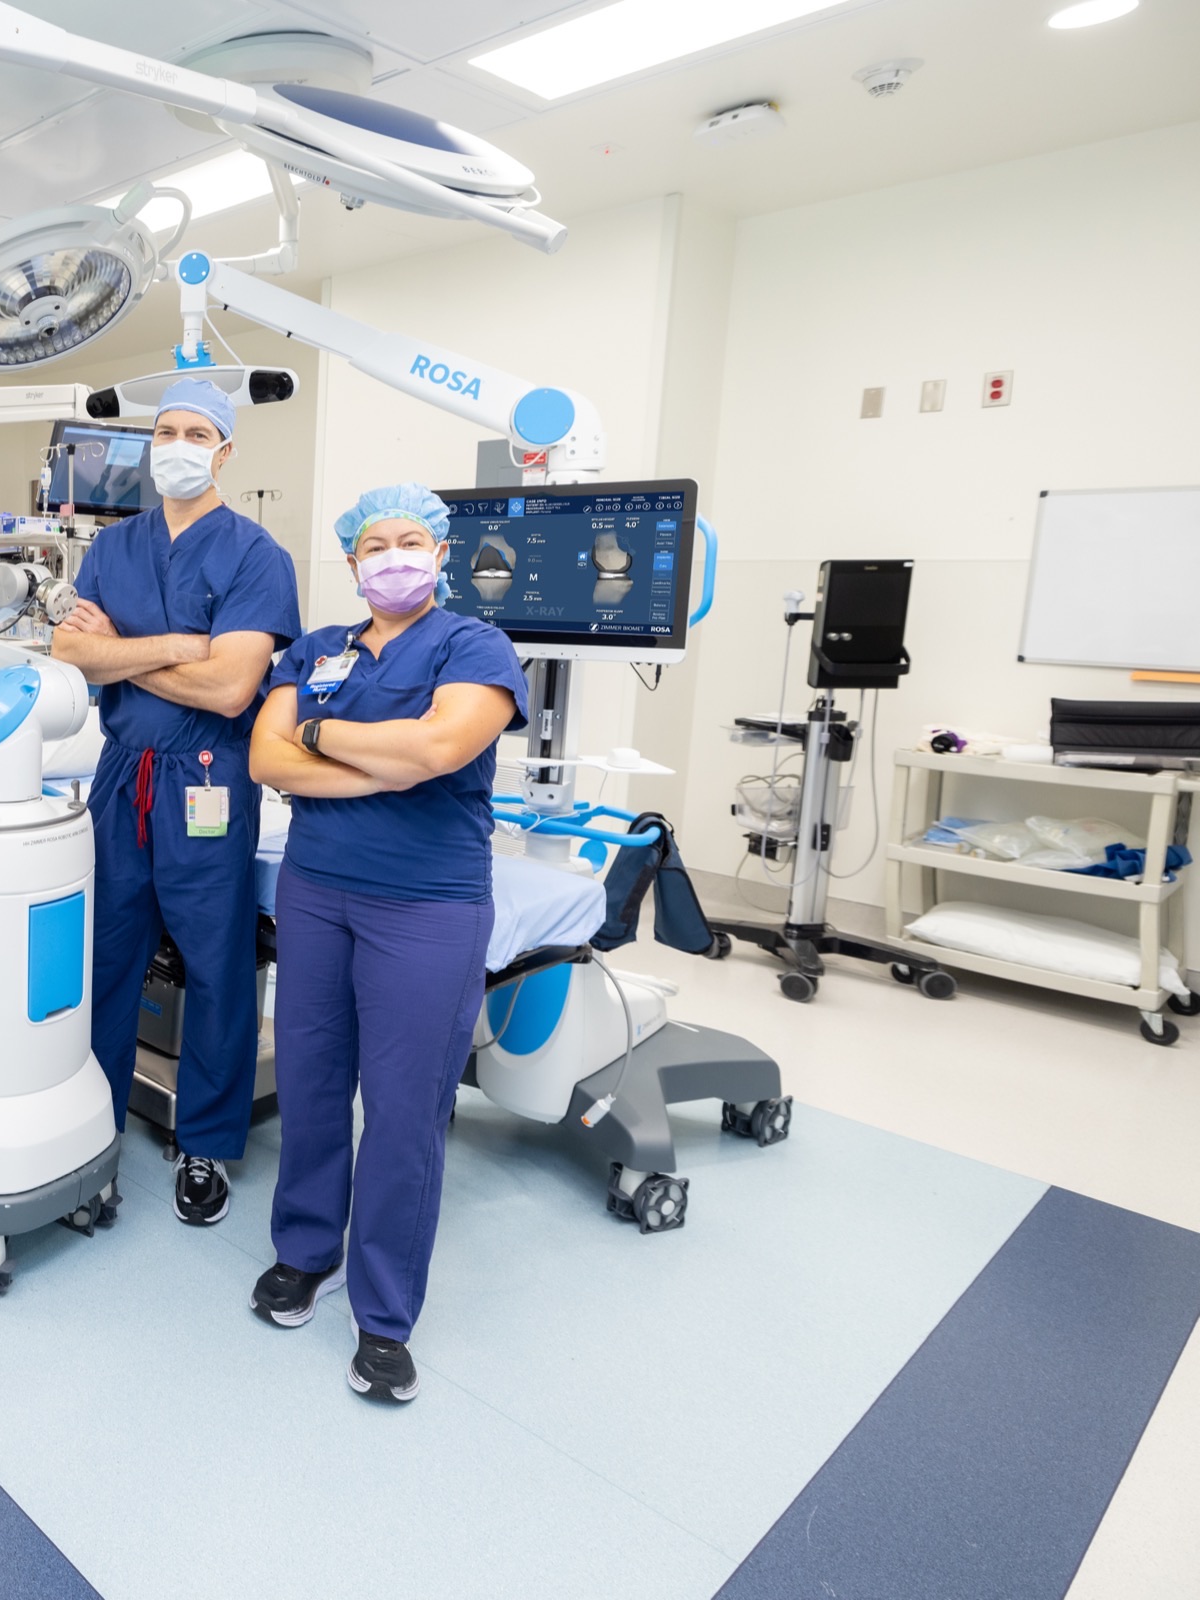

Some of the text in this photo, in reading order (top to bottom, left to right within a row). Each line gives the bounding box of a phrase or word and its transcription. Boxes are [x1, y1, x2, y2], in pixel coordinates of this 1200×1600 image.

[135, 60, 178, 85] stryker
[283, 162, 321, 182] BERCHTOLD
[409, 353, 481, 401] ROSA
[529, 573, 538, 581] M
[526, 606, 565, 616] X-RAY
